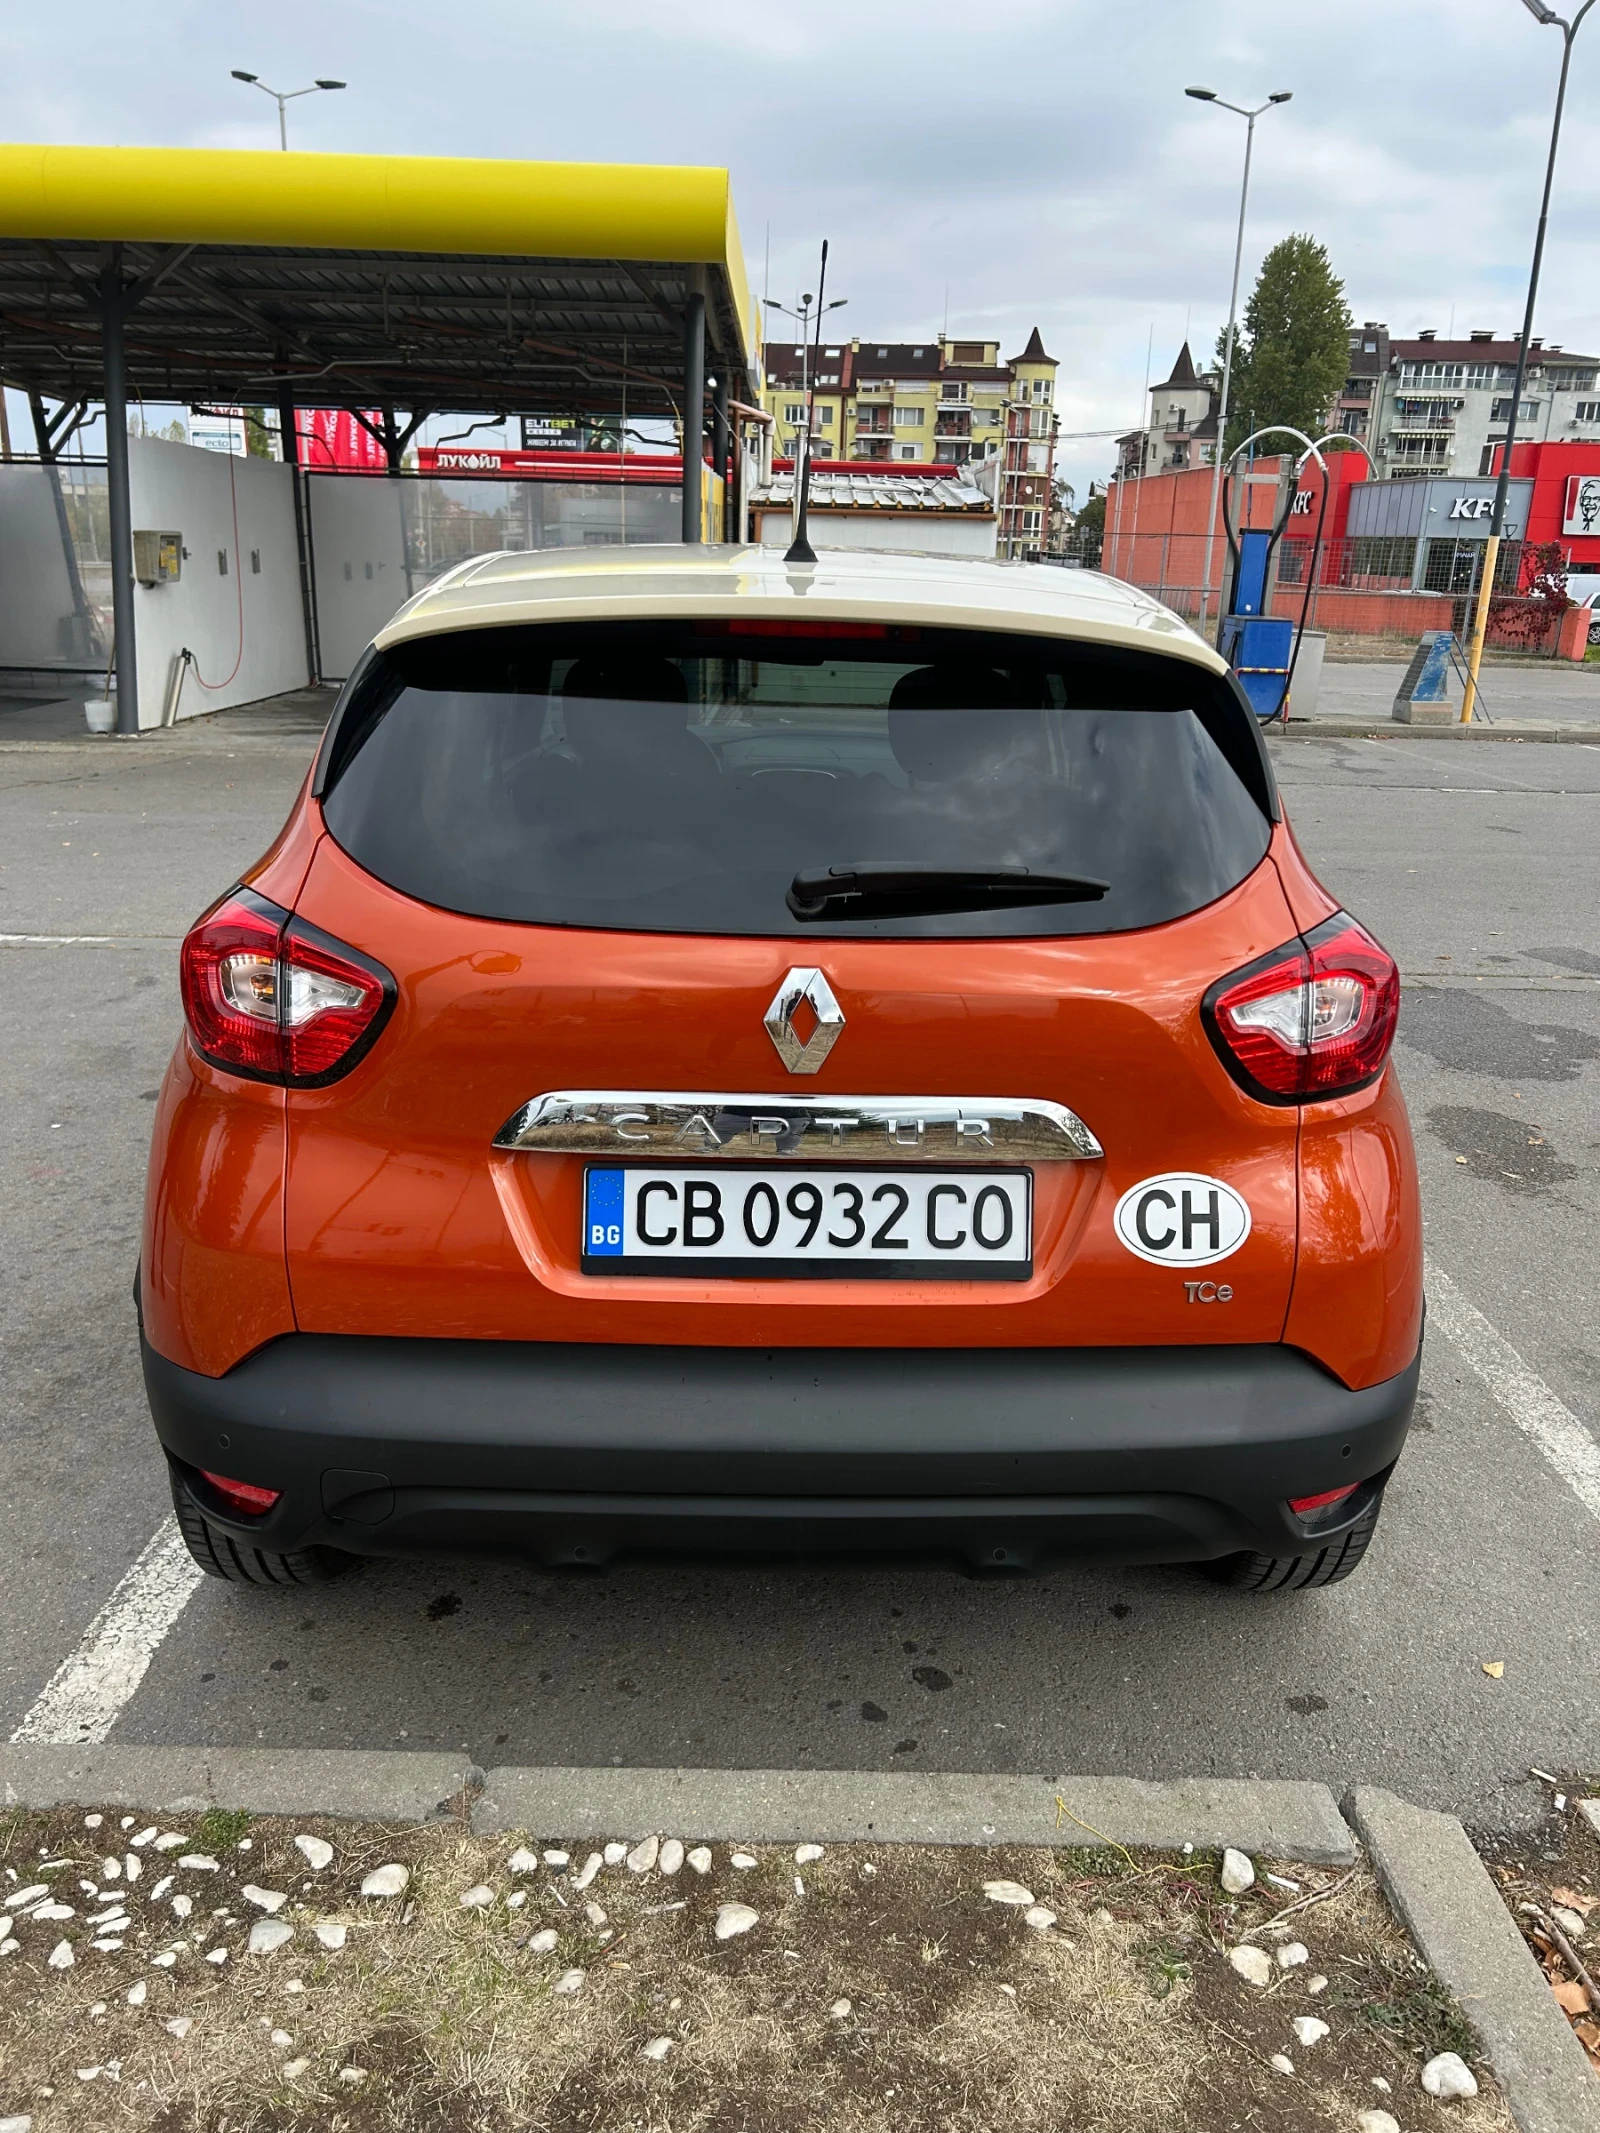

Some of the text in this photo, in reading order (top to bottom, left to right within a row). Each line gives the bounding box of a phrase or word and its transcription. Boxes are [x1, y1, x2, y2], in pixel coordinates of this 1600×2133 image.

[205, 440, 229, 448] ecto
[437, 453, 501, 469] ЛУКОЙЛ
[1291, 491, 1312, 514] KFC
[611, 1113, 995, 1148] CAPTUR
[637, 1180, 724, 1246] CB
[743, 1182, 909, 1249] 0932
[1136, 1189, 1219, 1250] CH
[591, 1225, 620, 1244] BG
[1184, 1281, 1233, 1303] TCe
